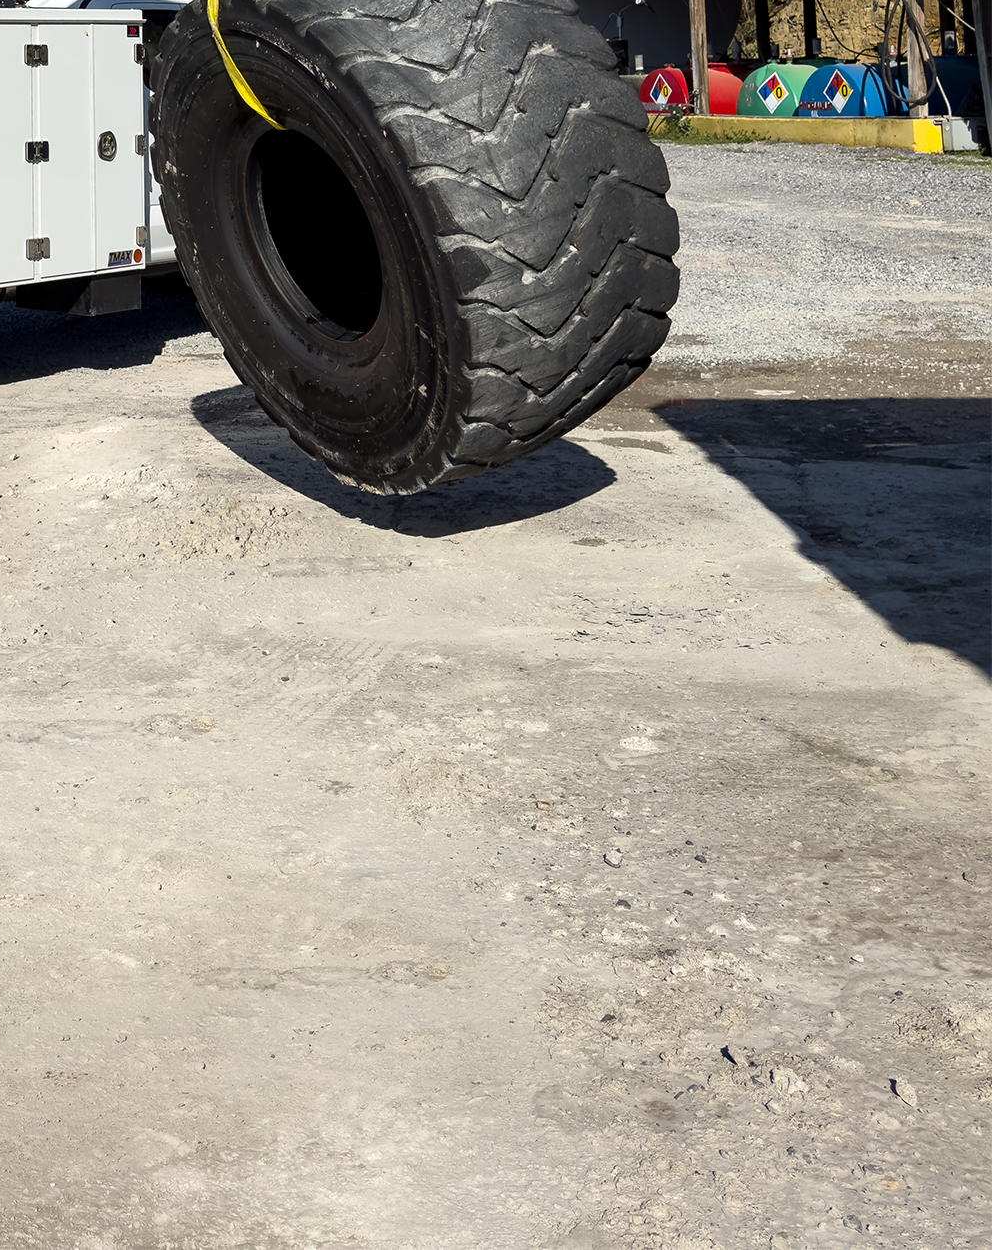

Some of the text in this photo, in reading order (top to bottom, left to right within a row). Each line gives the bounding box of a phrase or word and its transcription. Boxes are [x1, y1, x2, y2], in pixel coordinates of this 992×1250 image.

[663, 85, 669, 98] 0
[775, 86, 783, 99] 0
[841, 84, 848, 98] 0
[109, 251, 131, 262] TMAX
